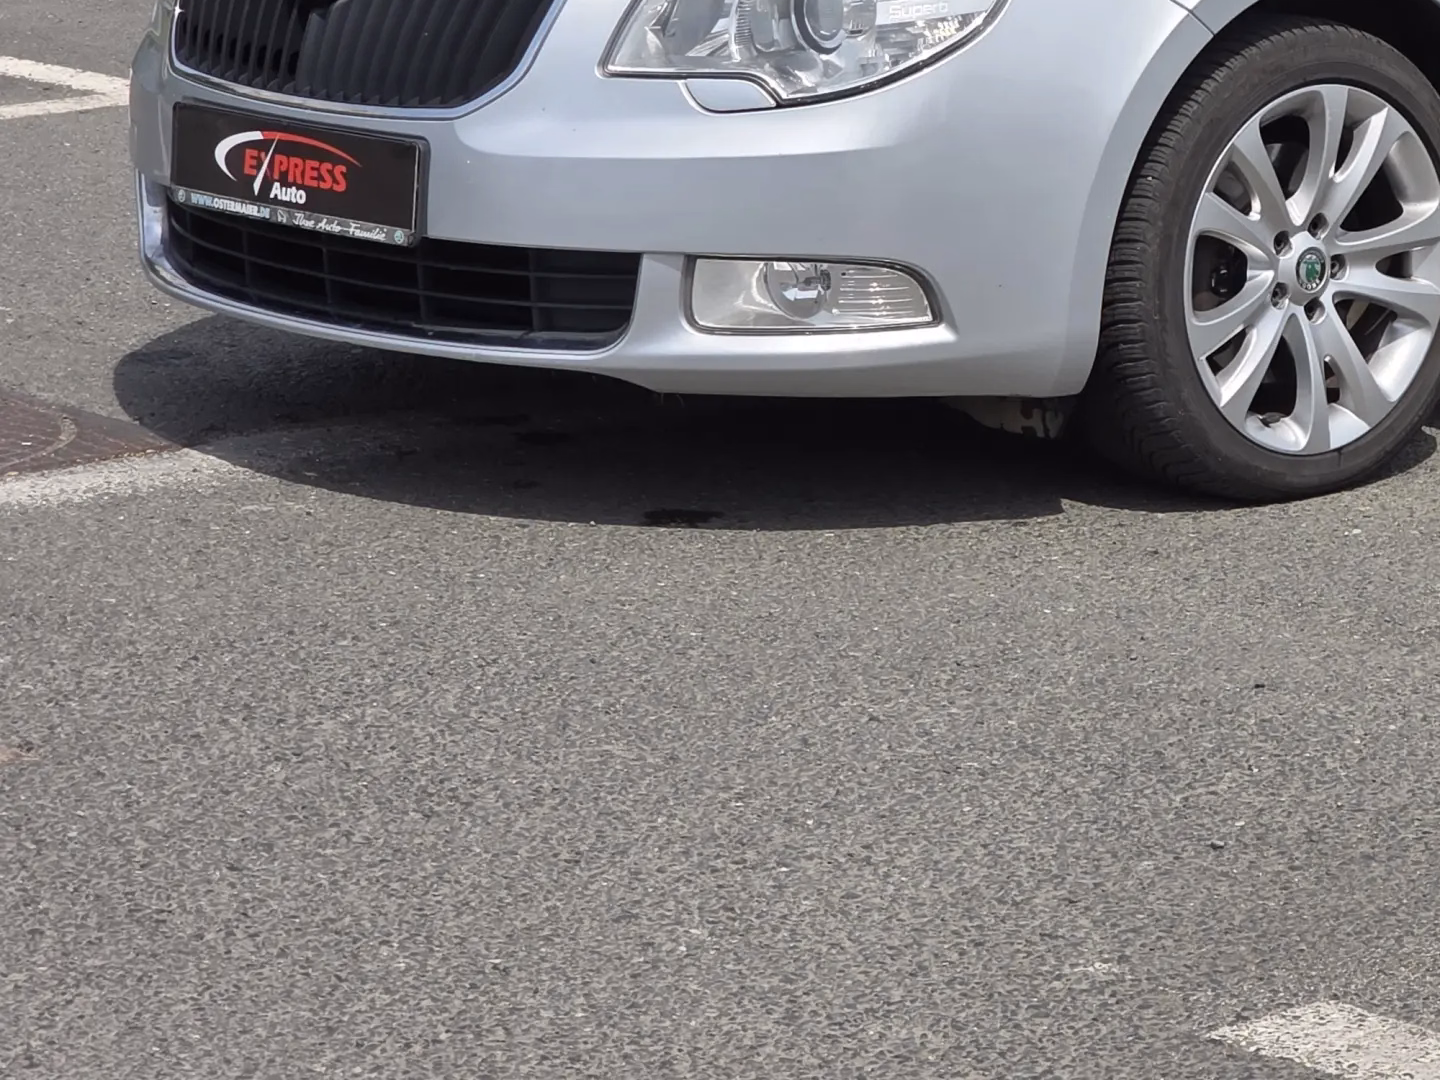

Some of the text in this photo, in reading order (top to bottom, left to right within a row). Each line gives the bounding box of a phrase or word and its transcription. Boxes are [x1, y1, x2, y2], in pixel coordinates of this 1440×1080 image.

[889, 2, 948, 21] Superb
[243, 148, 347, 193] EXPRESS
[269, 181, 307, 205] Auto
